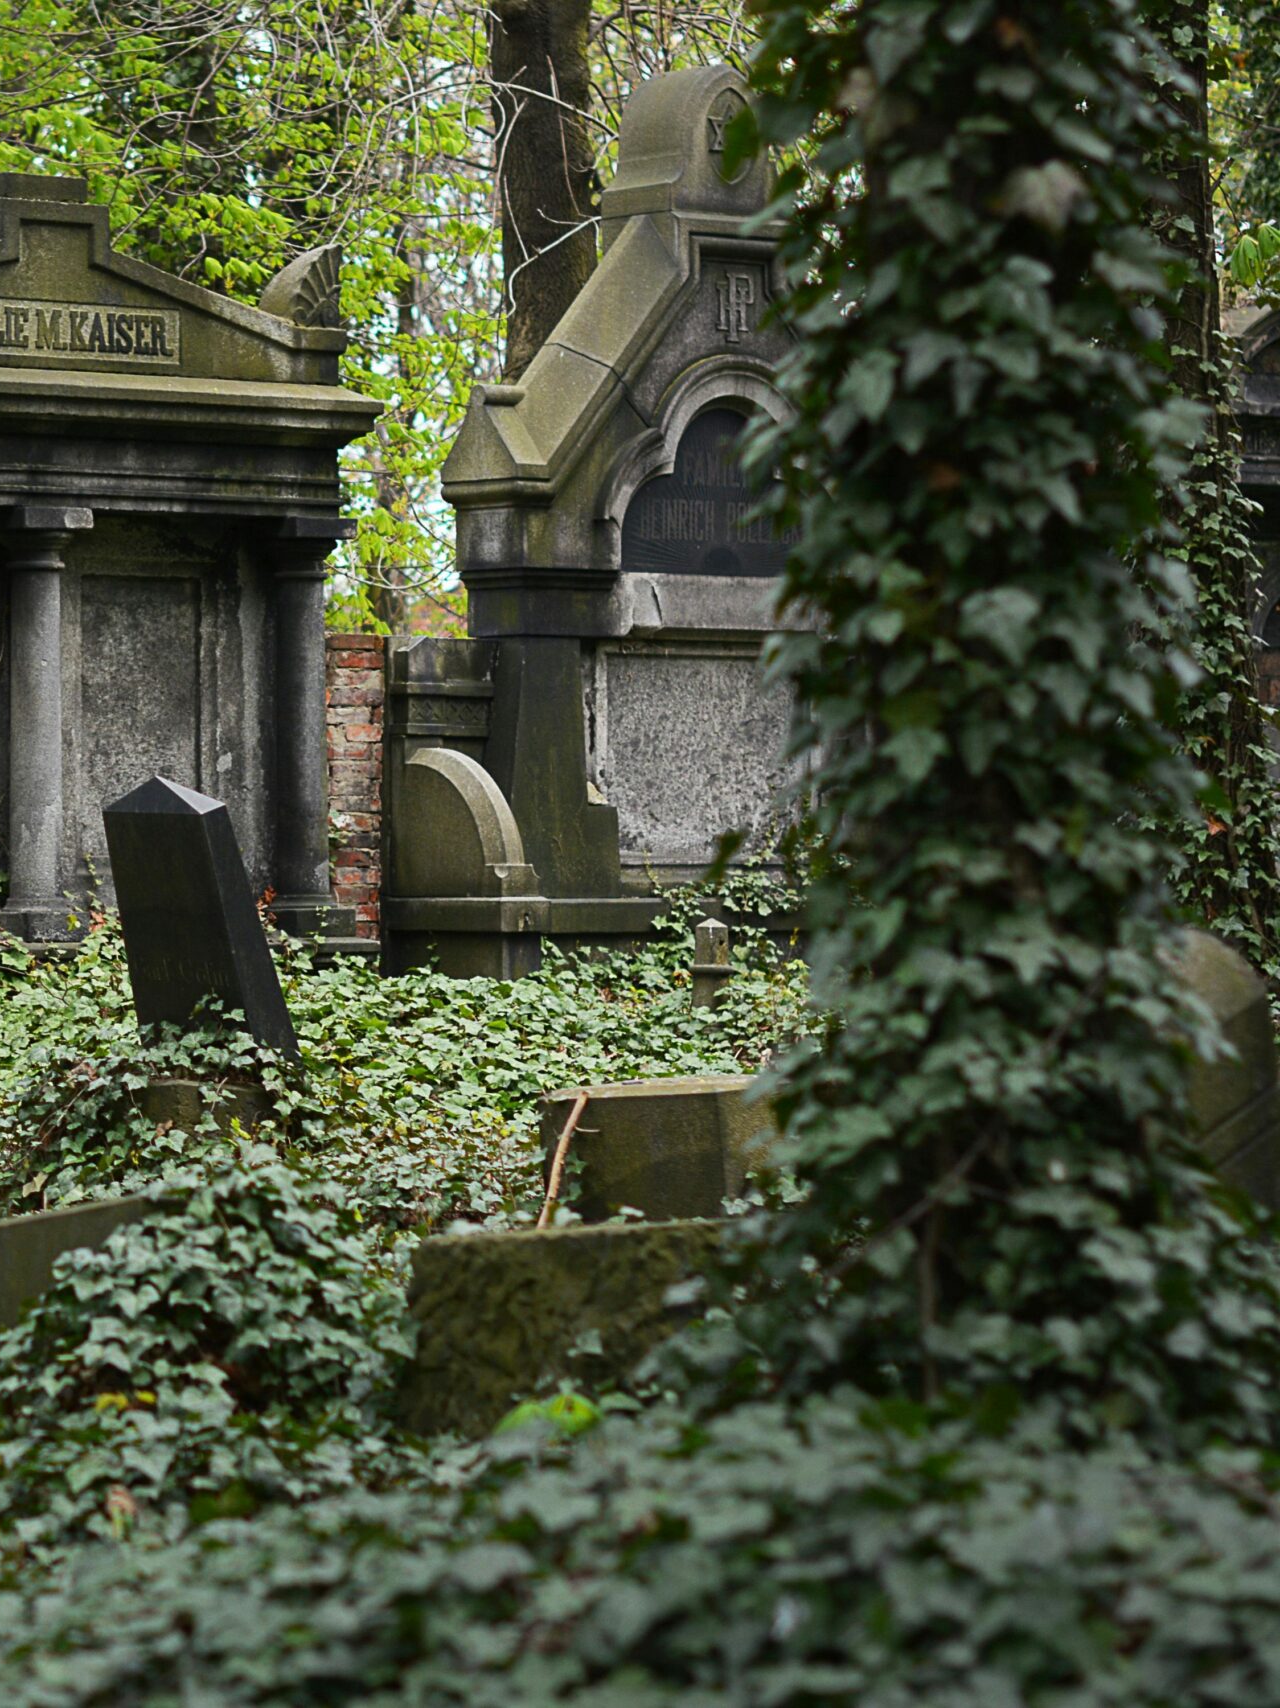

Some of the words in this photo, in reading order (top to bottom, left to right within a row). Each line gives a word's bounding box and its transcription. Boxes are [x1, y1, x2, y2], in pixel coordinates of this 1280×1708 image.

[69, 310, 174, 357] KAISER
[683, 449, 750, 488] FAMILI
[640, 498, 714, 541] HEINRICH
